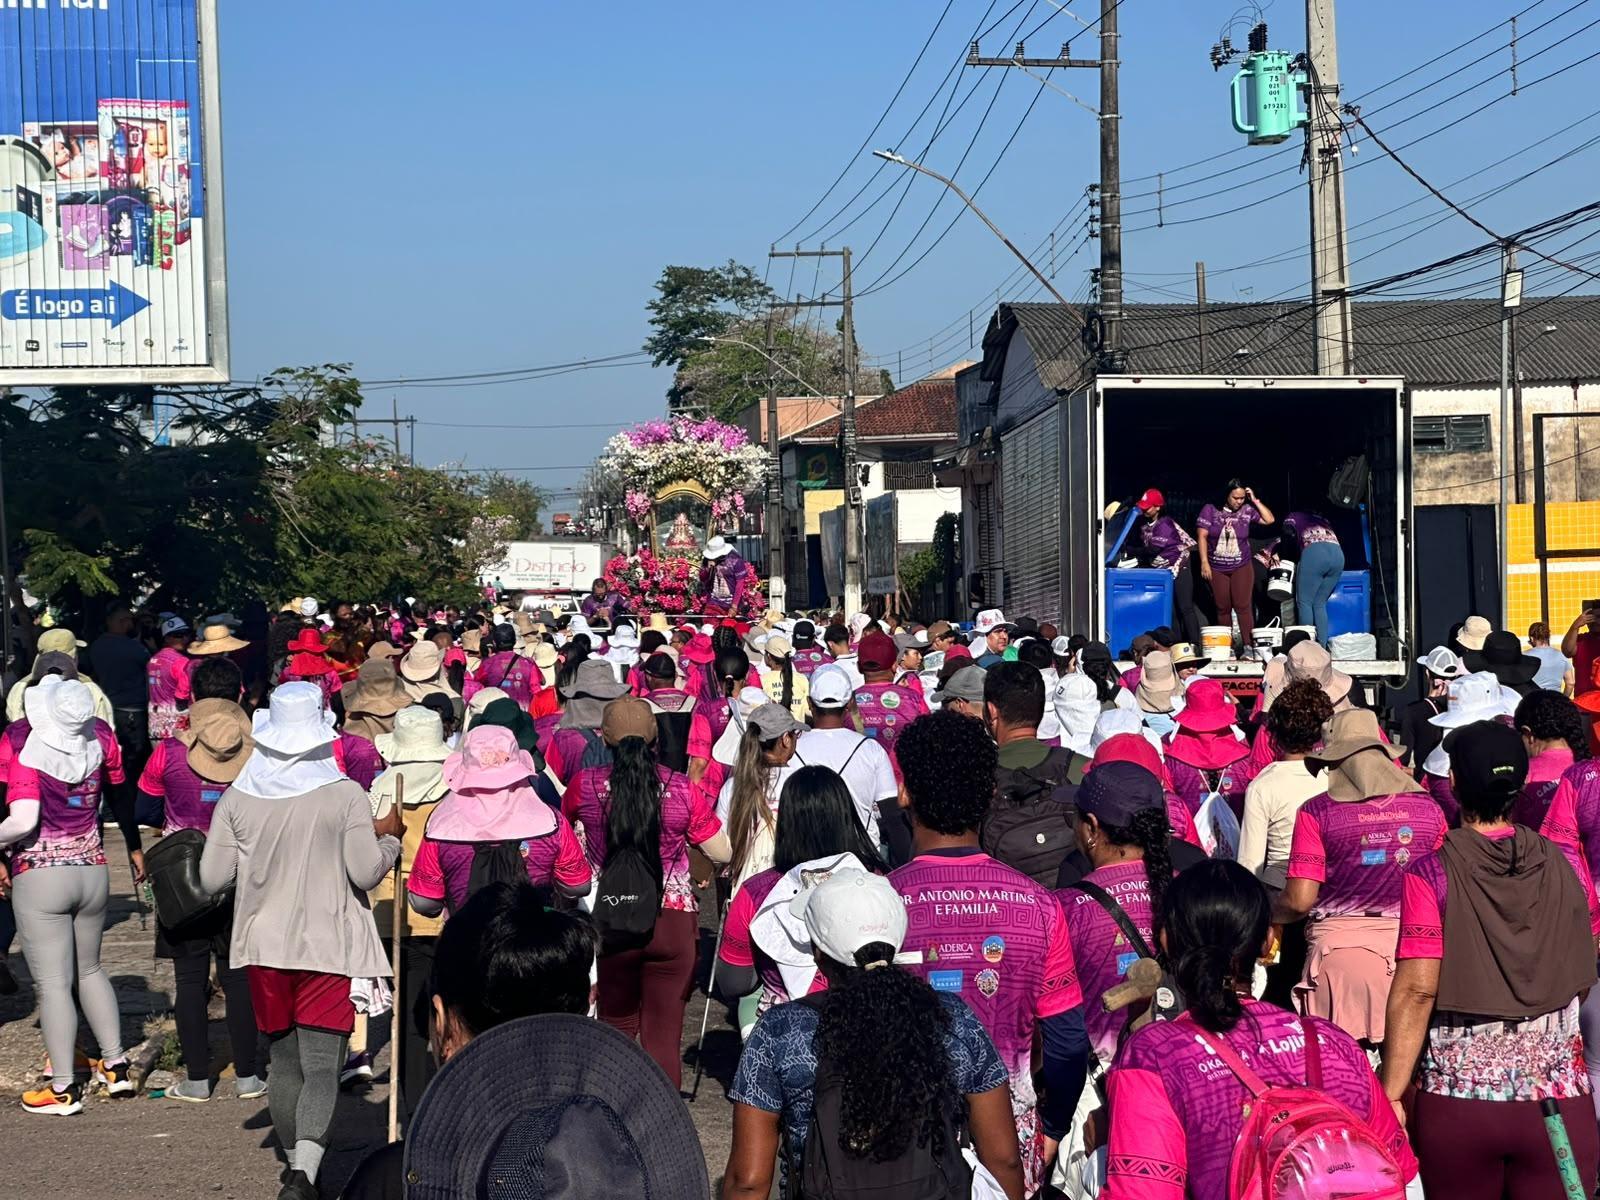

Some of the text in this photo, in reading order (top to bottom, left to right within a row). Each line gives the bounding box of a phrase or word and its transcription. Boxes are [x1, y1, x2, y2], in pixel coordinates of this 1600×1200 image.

[15, 290, 29, 314] É
[35, 295, 84, 318] logo
[1221, 681, 1263, 690] FACCH
[918, 889, 974, 903] ANTONIO
[978, 889, 1035, 904] MARTINS
[1125, 893, 1150, 904] FAM
[935, 903, 998, 915] E FAMILIA
[938, 942, 973, 953] ADERCA
